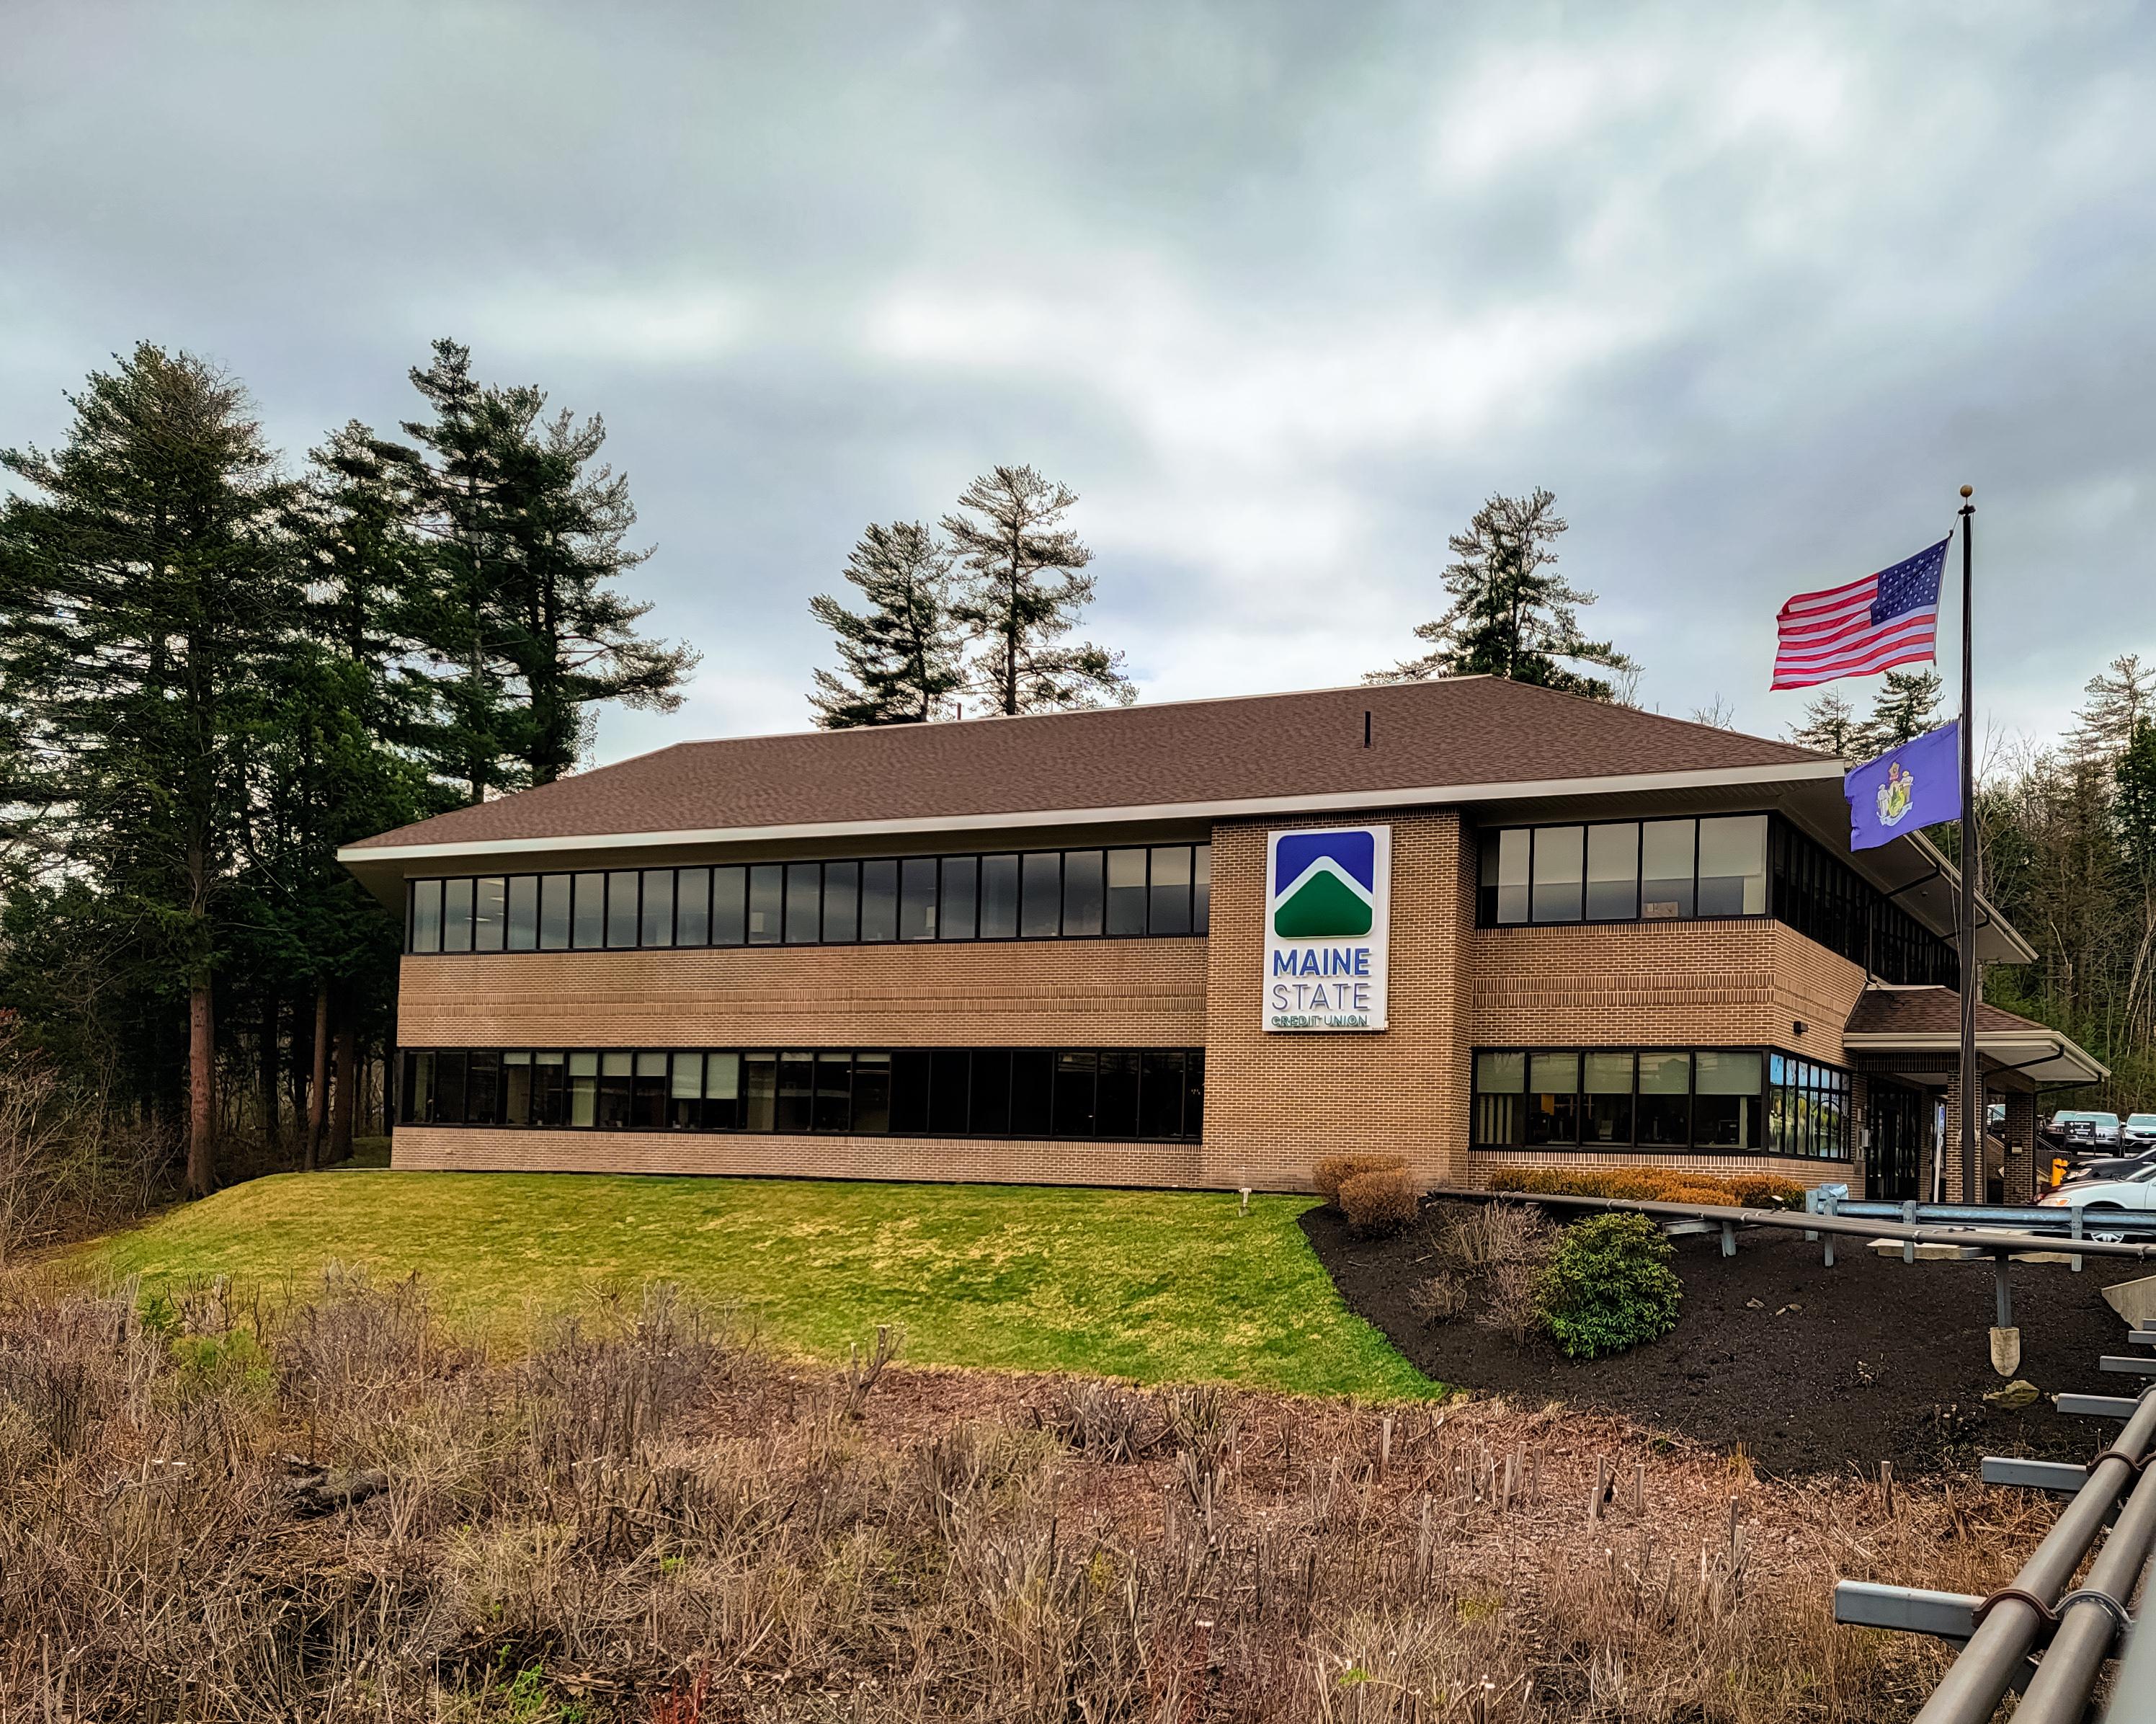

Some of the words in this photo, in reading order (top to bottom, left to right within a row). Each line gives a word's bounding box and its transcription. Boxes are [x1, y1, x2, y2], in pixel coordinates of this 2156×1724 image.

[1273, 947, 1370, 977] MAINE
[1271, 982, 1369, 1010] STATE
[1271, 1015, 1320, 1026] CREDIT
[1324, 1014, 1368, 1026] UNION
